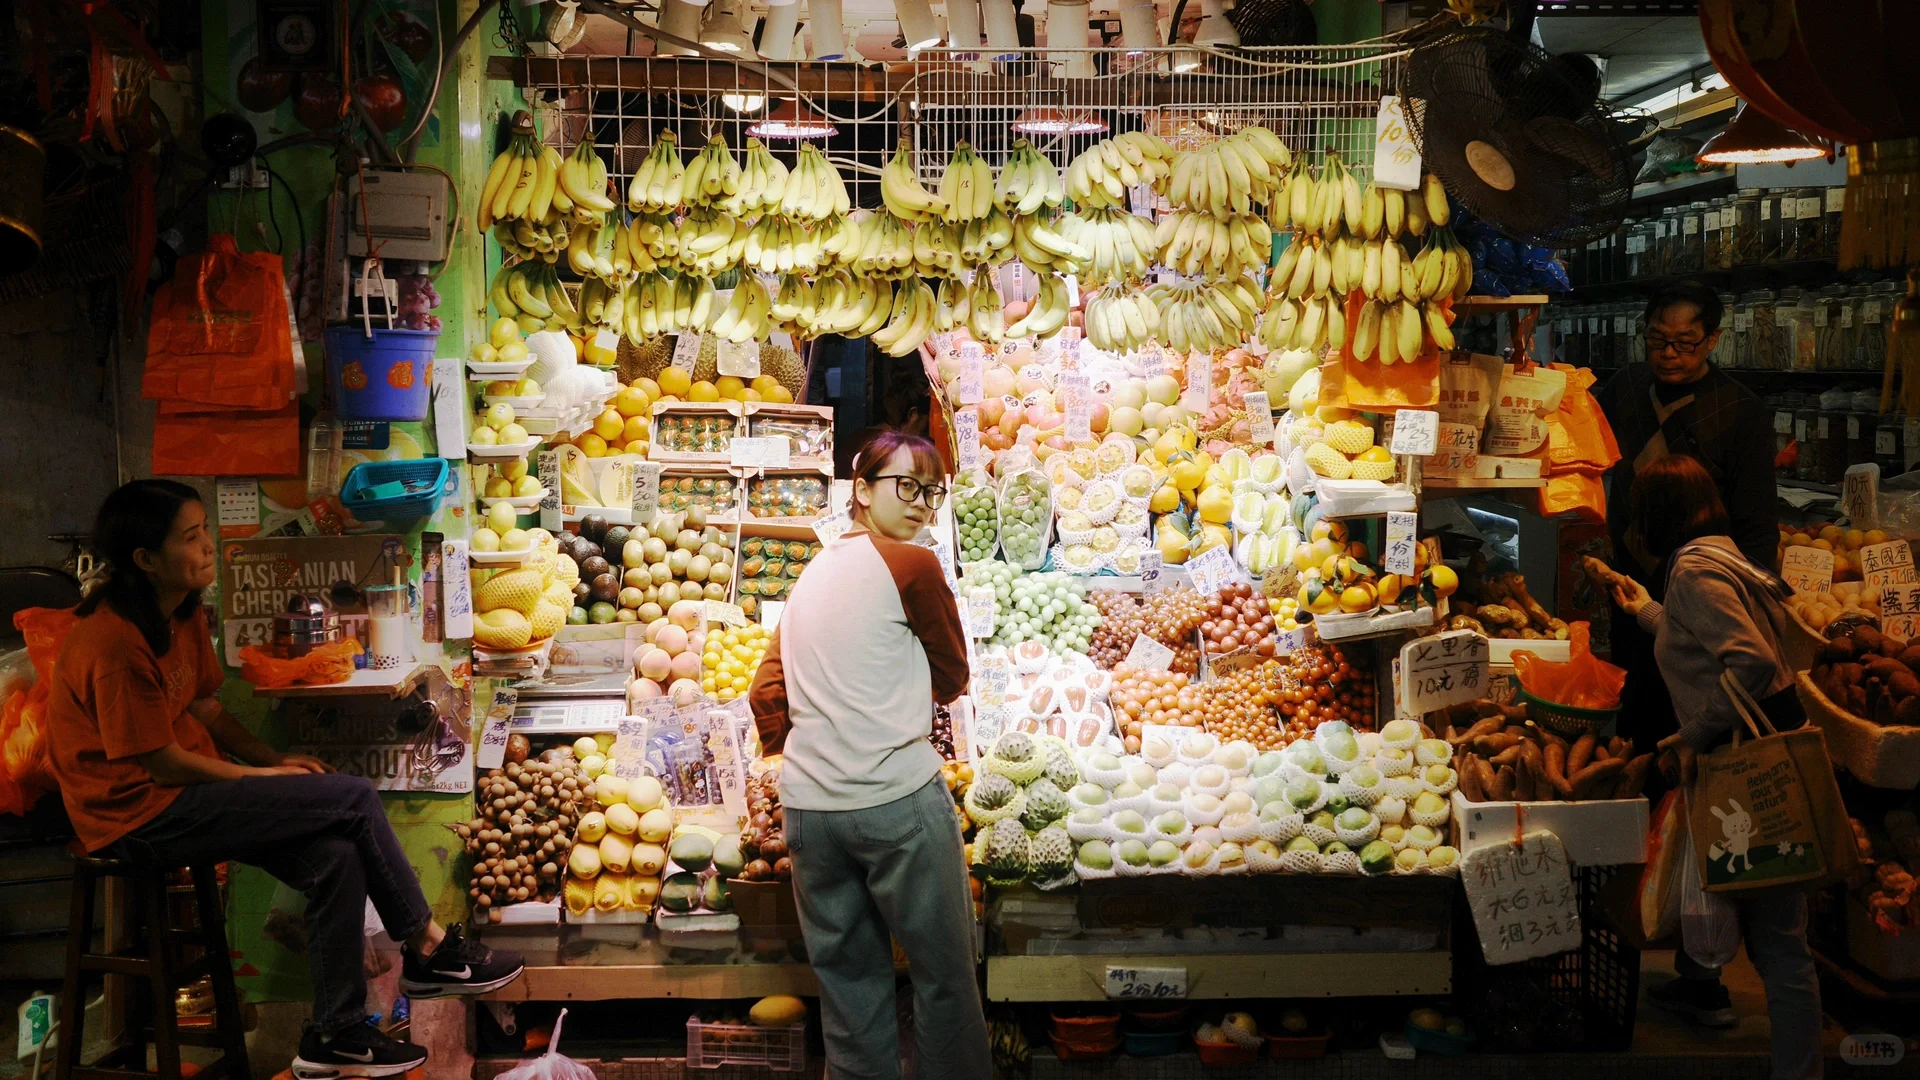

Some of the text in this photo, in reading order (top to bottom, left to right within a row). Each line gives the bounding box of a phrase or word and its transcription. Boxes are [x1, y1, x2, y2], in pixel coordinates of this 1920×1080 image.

[1847, 475, 1869, 494] 10元
[1864, 544, 1907, 573] 泰國蛋
[230, 560, 356, 589] TASANIAN
[232, 587, 332, 615] CHERS
[1415, 636, 1487, 663] 七里香
[454, 781, 467, 789] NET
